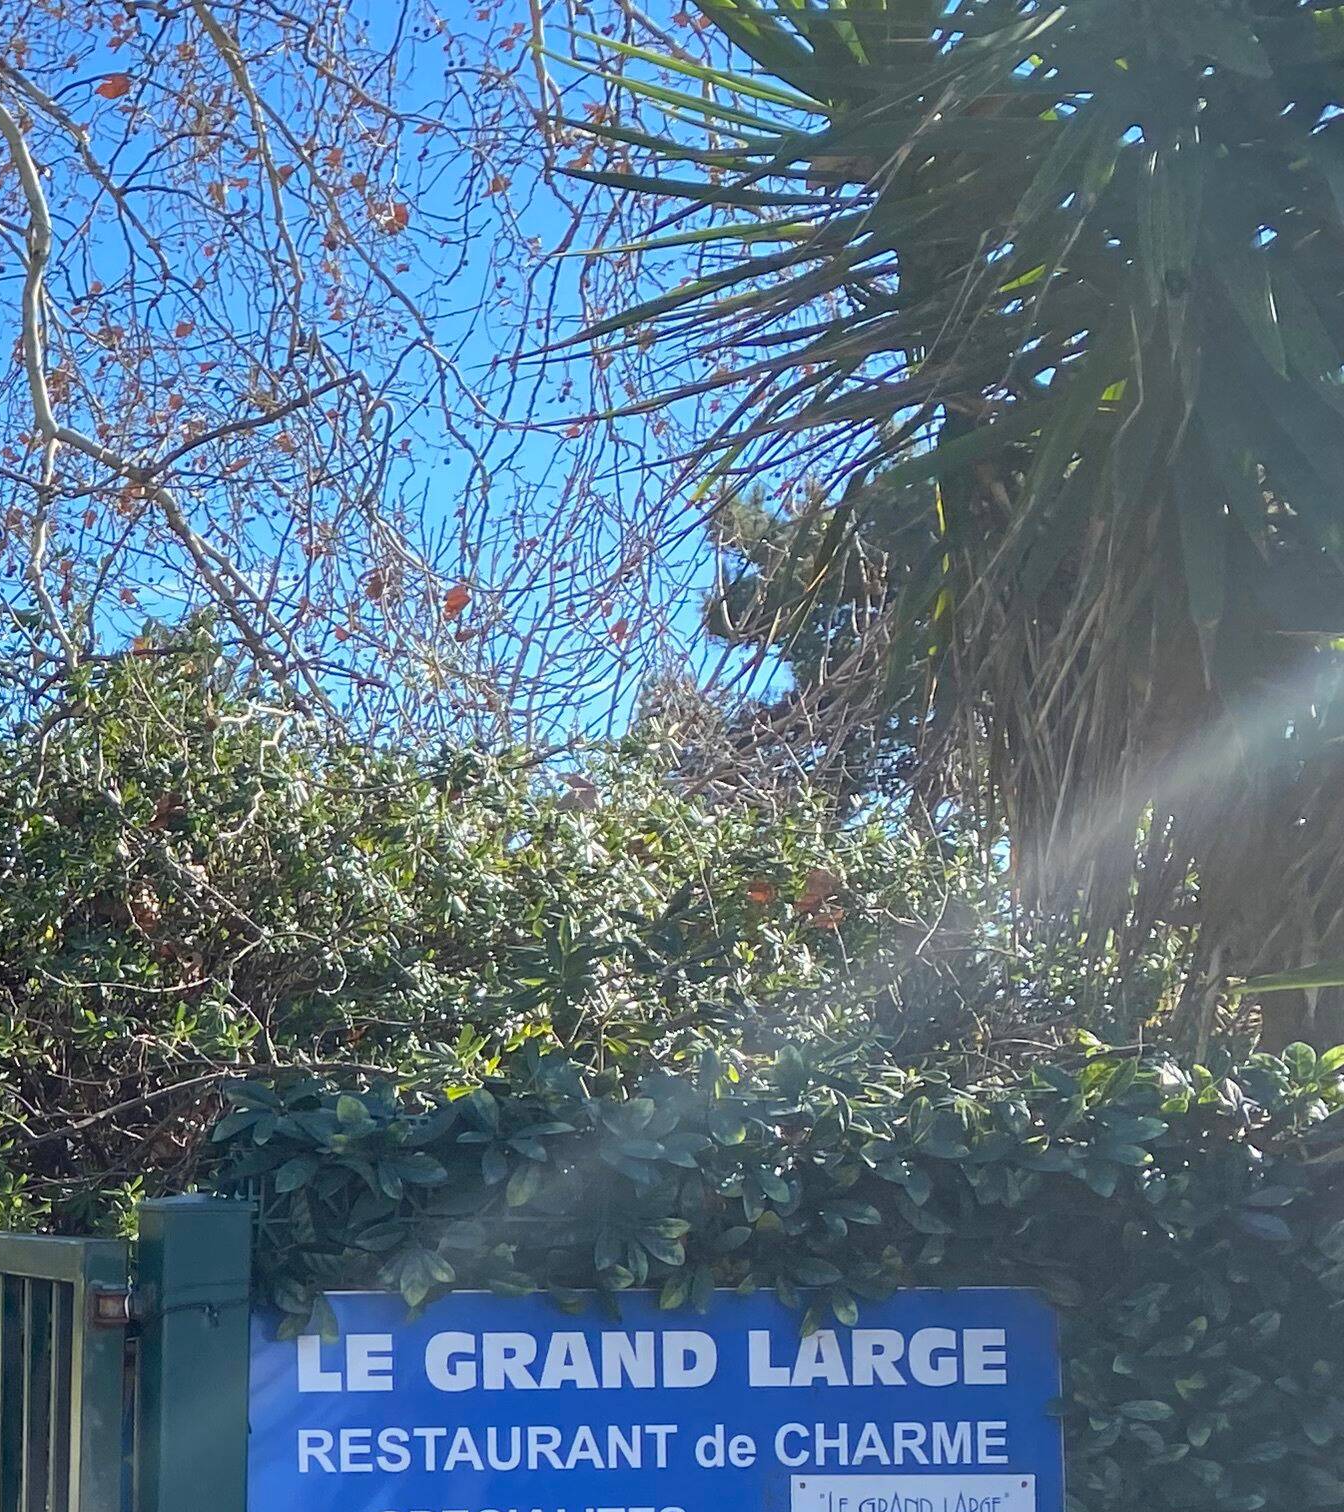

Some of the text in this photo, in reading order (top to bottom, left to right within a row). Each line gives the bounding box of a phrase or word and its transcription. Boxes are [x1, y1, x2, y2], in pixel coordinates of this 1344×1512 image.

[297, 1327, 1008, 1393] LE GRAND LARGE
[297, 1420, 1009, 1473] RESTAURANT de CHARME
